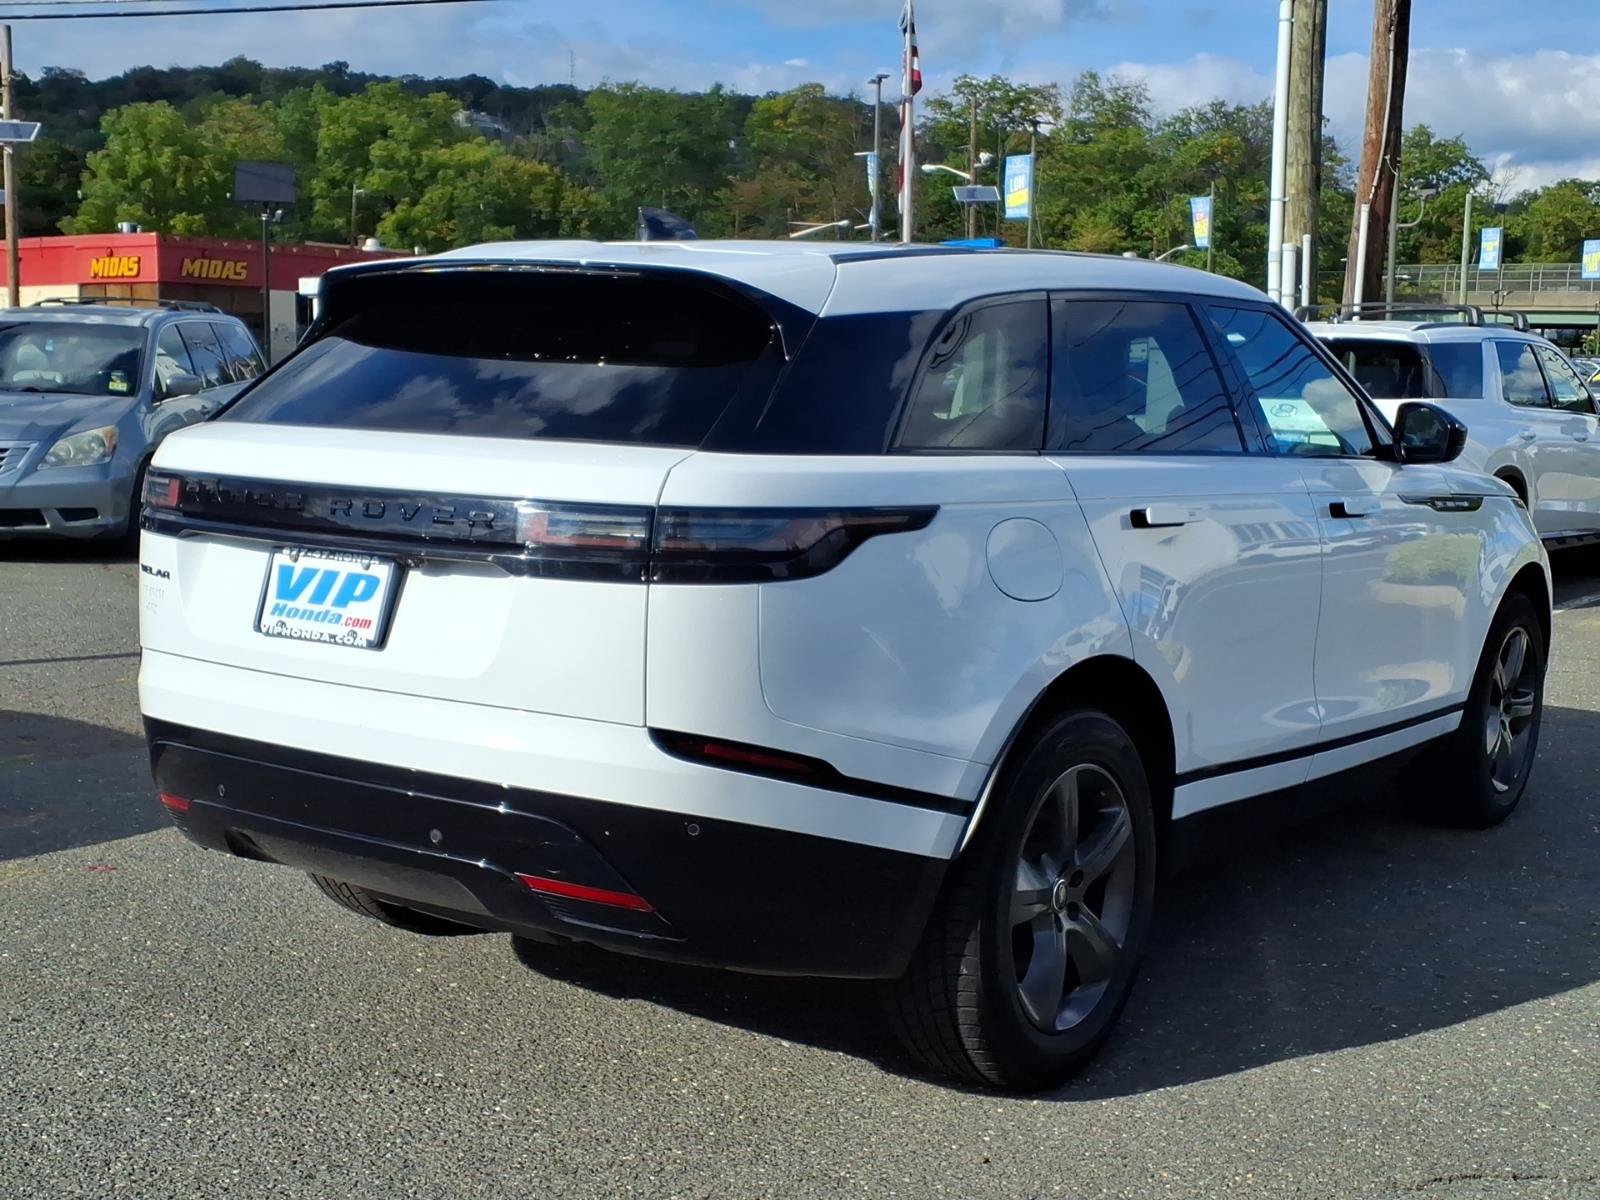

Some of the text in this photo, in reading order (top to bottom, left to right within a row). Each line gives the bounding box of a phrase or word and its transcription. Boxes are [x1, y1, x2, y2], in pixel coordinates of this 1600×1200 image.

[90, 256, 139, 278] MIDAS
[181, 258, 248, 281] MIDAS
[331, 498, 495, 531] ROVER
[275, 563, 380, 608] VIP
[260, 624, 368, 649] VIPHONDA.COM
